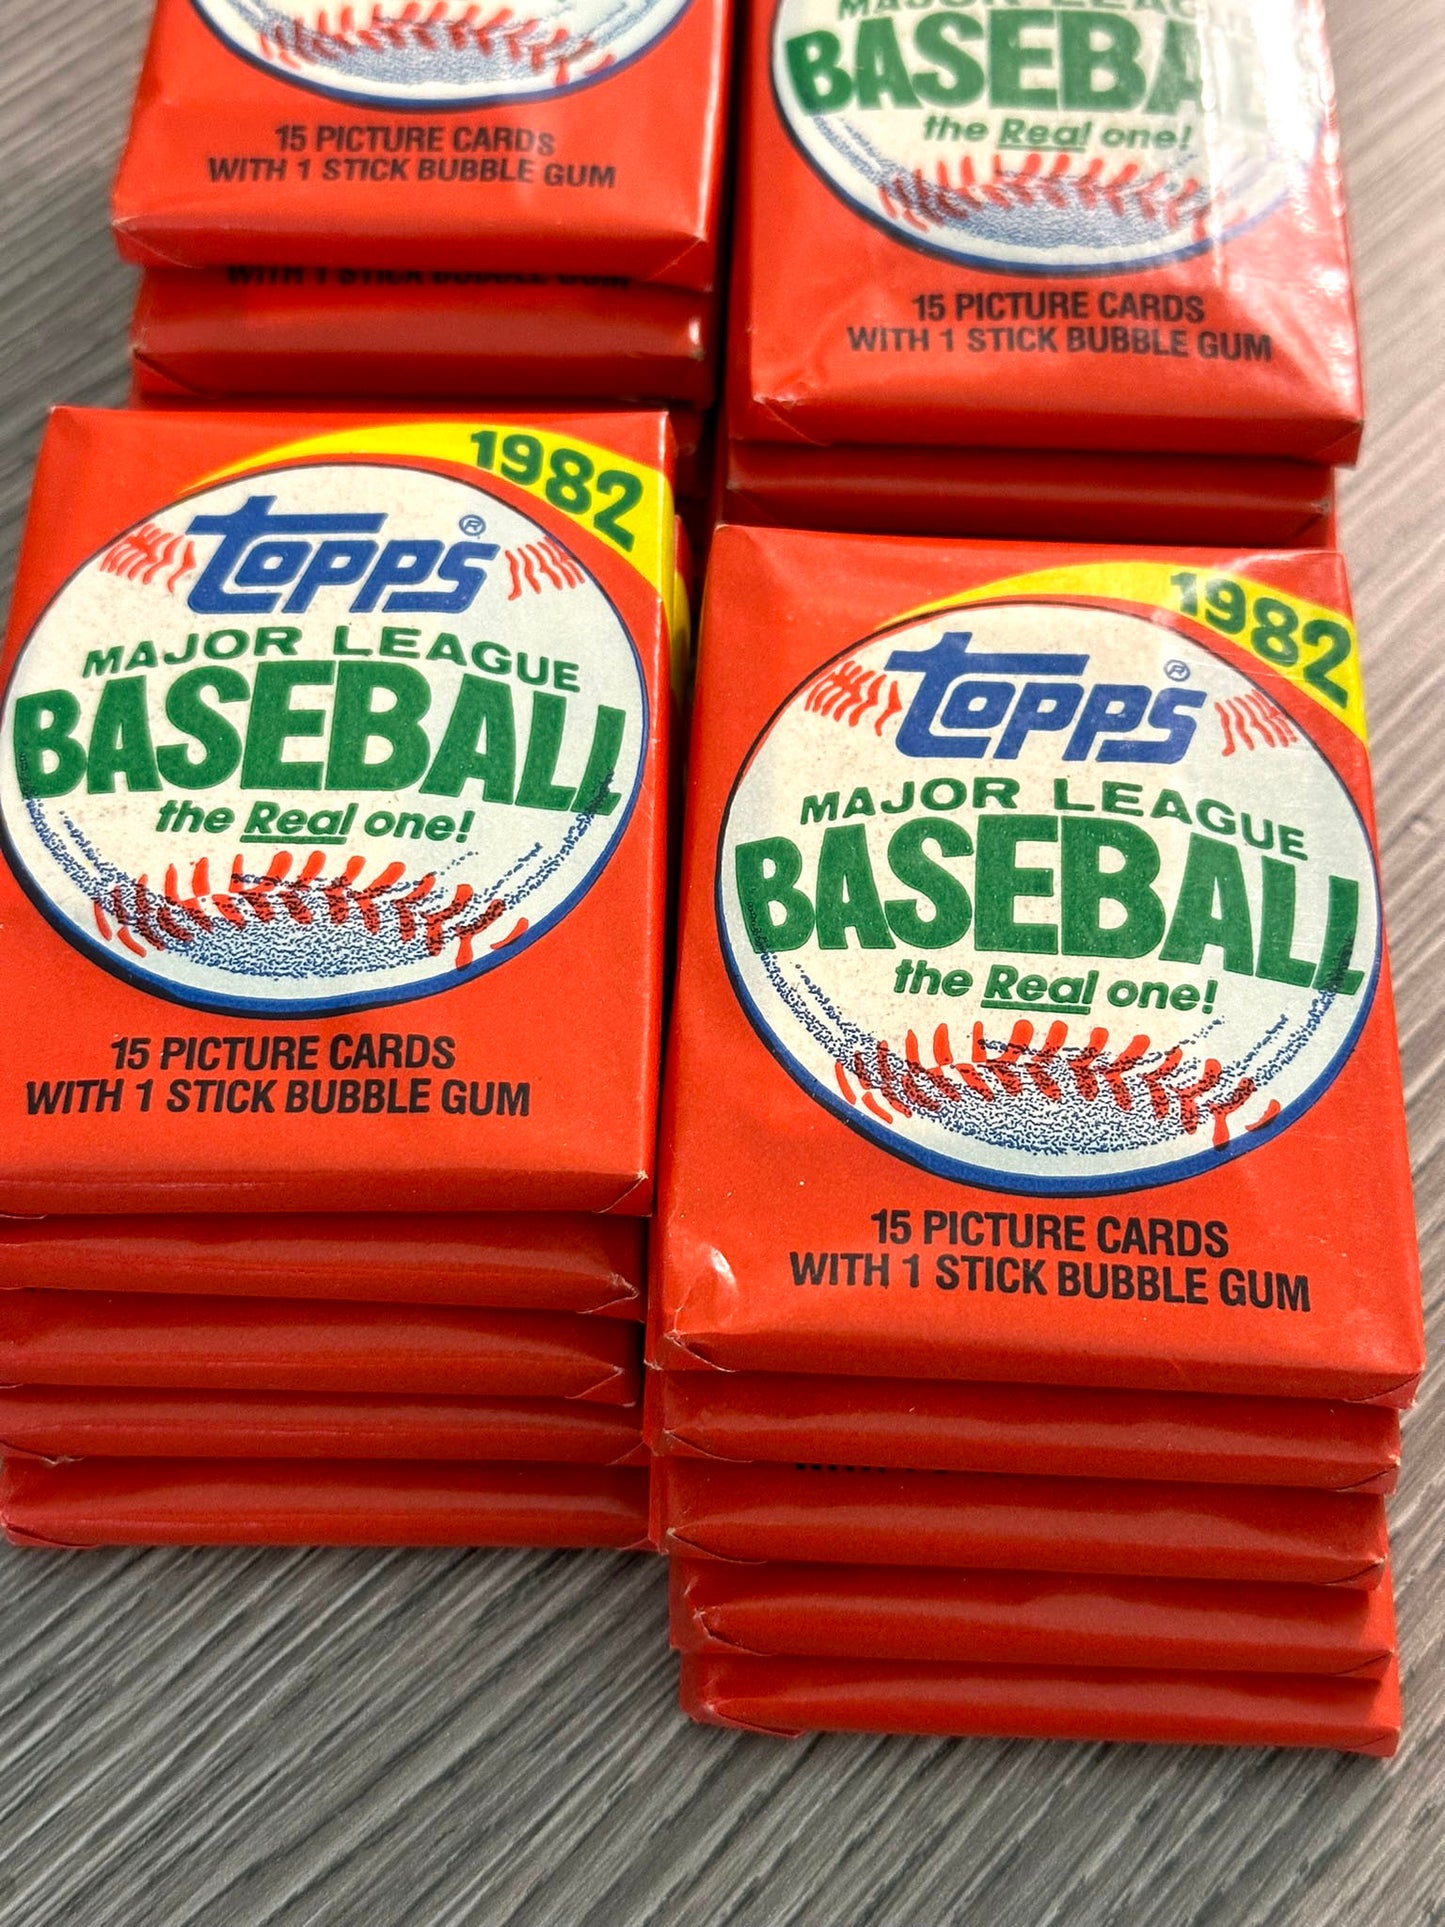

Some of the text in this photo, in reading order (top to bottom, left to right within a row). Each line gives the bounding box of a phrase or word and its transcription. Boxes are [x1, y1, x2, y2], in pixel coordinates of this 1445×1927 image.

[786, 8, 1268, 126] BASEBAL
[276, 125, 556, 156] 15 PICTURE CARDS
[923, 115, 1193, 151] the Real one!
[208, 156, 617, 189] WITH 1 STICK BUBBLE GUM
[912, 291, 1205, 324] 15 PICTURE CARDS
[847, 325, 1272, 363] WITH 1 STICK BUBBLE GUM
[470, 429, 644, 553] 1982
[82, 625, 582, 693] MAJOR LEAGUE
[1169, 571, 1352, 710] 1982
[14, 660, 626, 816] BASEBALL
[156, 799, 475, 843] the Real one!
[799, 777, 1309, 862] MAJOR LEAGUE
[734, 813, 1366, 996] BASEBALL
[893, 959, 1218, 1014] the Real one!
[110, 1034, 457, 1071] 15 PICTURE CARDS
[26, 1078, 531, 1117] WITH 1 STICK BUBBLE GUM
[871, 1208, 1229, 1259] 15 PICTURE CARDS
[789, 1251, 1312, 1313] WITH 1 STICK BUBBLE GUM
